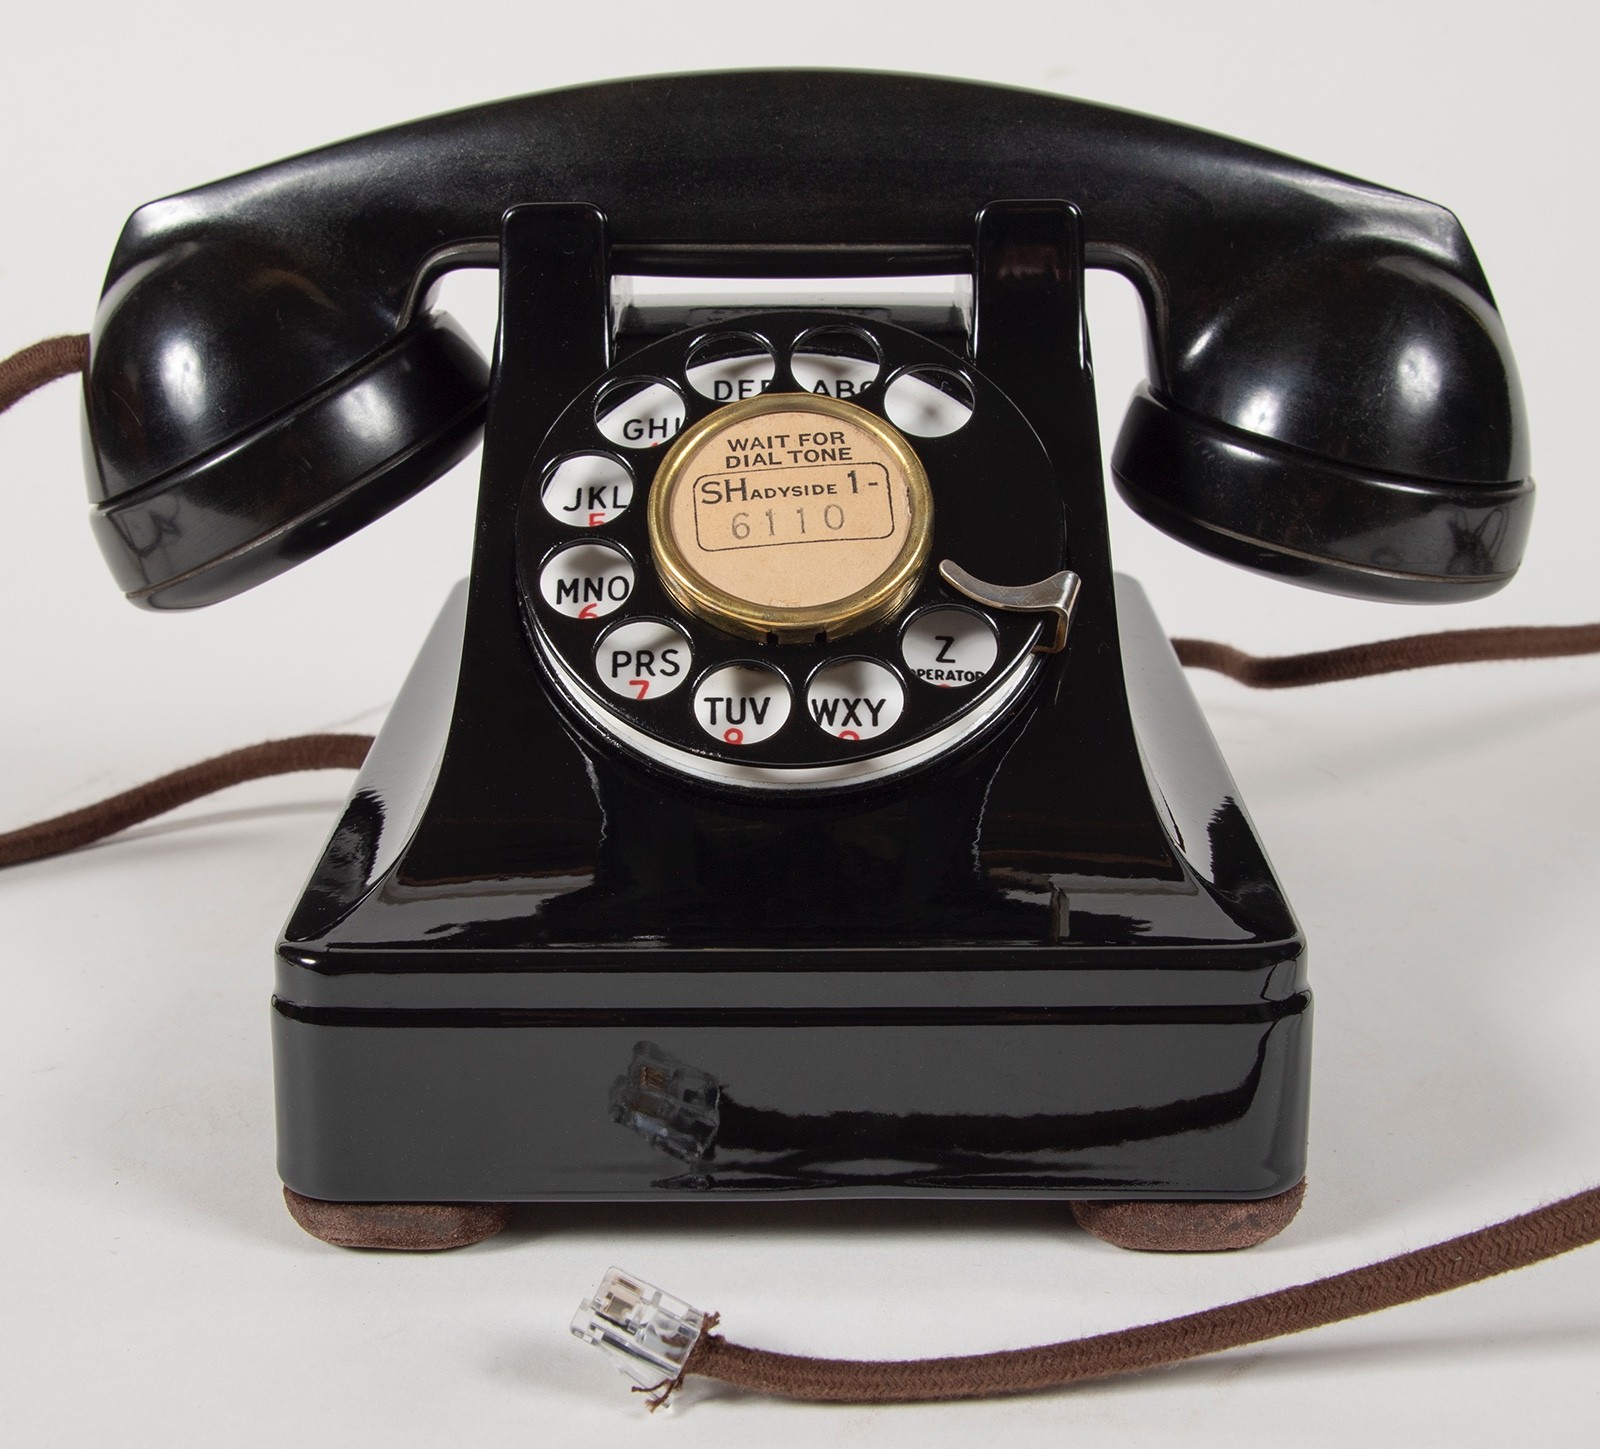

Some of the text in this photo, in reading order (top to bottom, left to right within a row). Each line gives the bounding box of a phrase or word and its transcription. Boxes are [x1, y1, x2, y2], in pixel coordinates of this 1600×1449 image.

[622, 417, 680, 441] GHI
[727, 431, 846, 452] WAIT FOR
[725, 447, 853, 469] DIAL TONE
[562, 485, 628, 512] JKL
[701, 477, 838, 505] SHADYSIDE
[731, 503, 845, 540] 6110
[556, 576, 630, 605] MNO
[611, 649, 681, 678] PRS
[934, 635, 956, 664] Z
[910, 668, 986, 682] PERATO
[629, 679, 650, 700] 7
[703, 697, 771, 725] TUV
[811, 698, 887, 727] WXY
